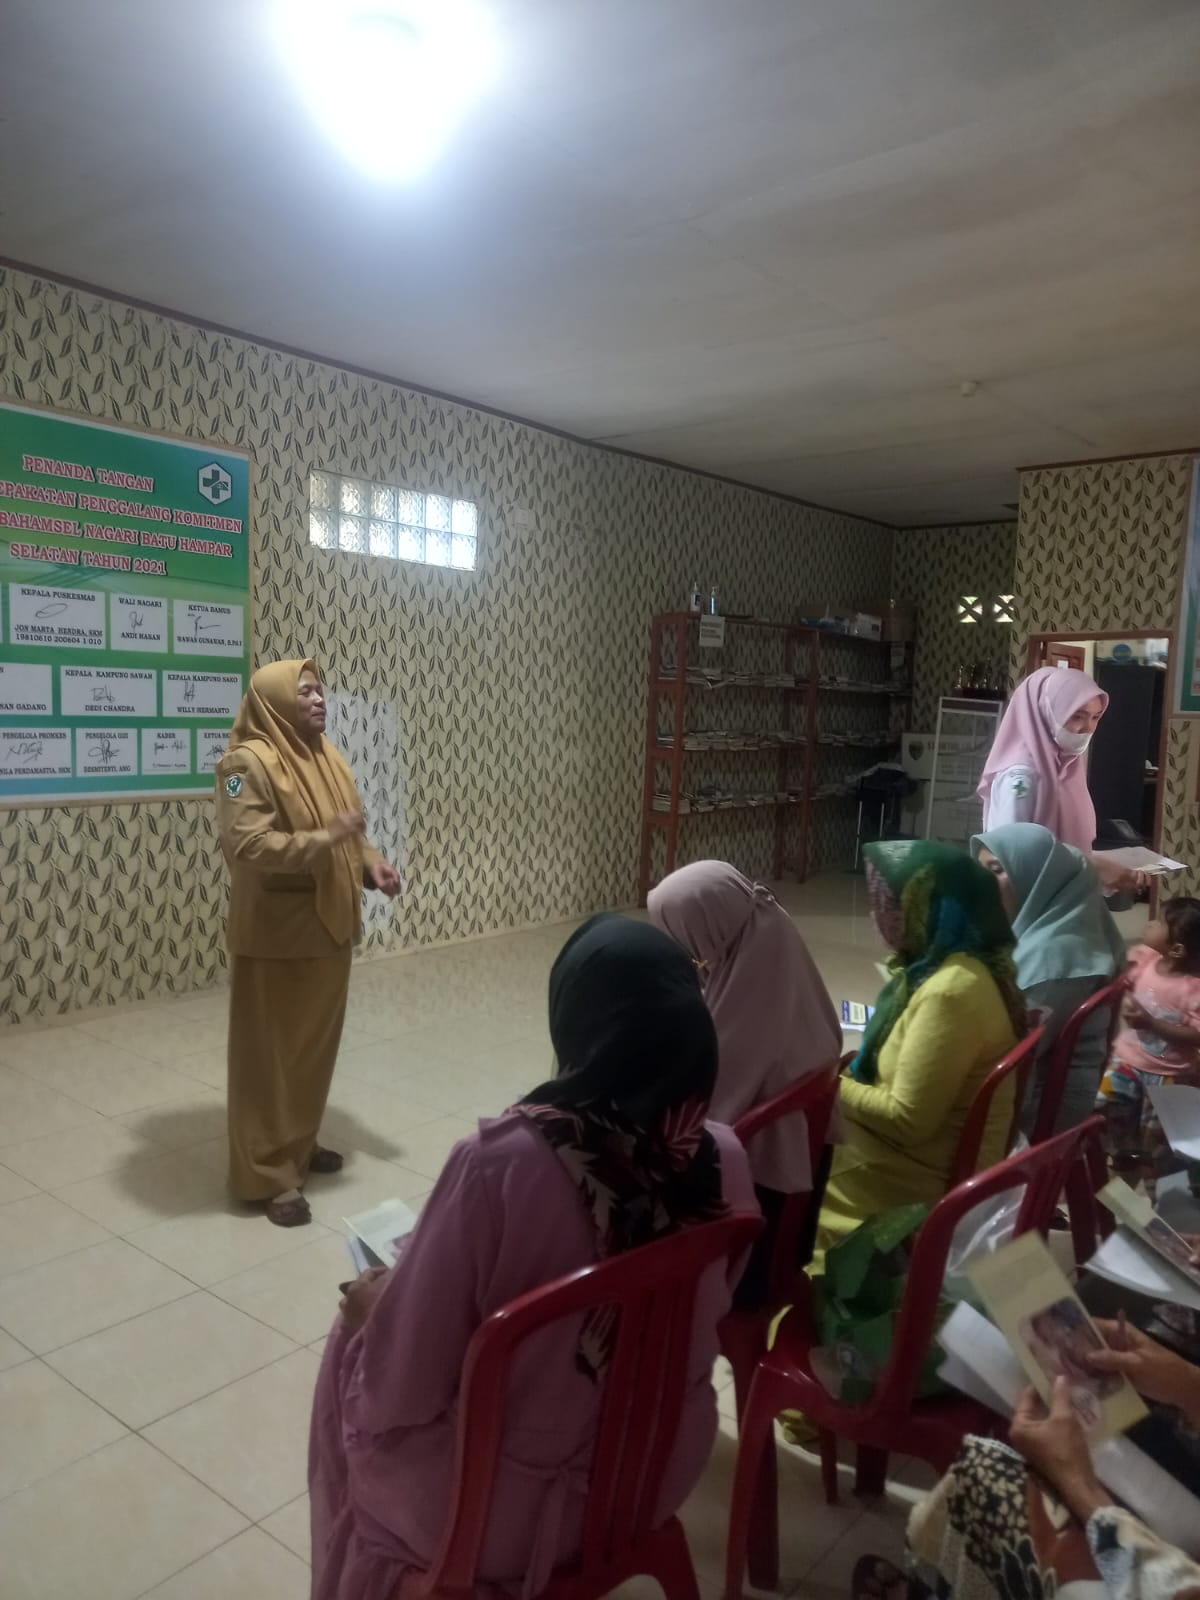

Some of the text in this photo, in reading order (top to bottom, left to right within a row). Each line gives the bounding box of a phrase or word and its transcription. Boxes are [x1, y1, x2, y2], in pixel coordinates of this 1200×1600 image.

[23, 455, 153, 492] PENANDA TANGAN
[80, 494, 171, 522] PENGGALANG
[174, 509, 242, 533] KOMITMEN
[84, 524, 139, 545] NAGARI
[141, 532, 176, 549] BATU
[180, 537, 232, 557] HAMPAR
[10, 543, 167, 575] SELATAN TAHUN 2021
[21, 588, 96, 602] KEPALA PUSKESMAS
[119, 597, 162, 608] WALI NAGARI
[188, 604, 209, 613] KETUA
[65, 669, 93, 678] KEPALA
[96, 670, 129, 679] KAMPUNG
